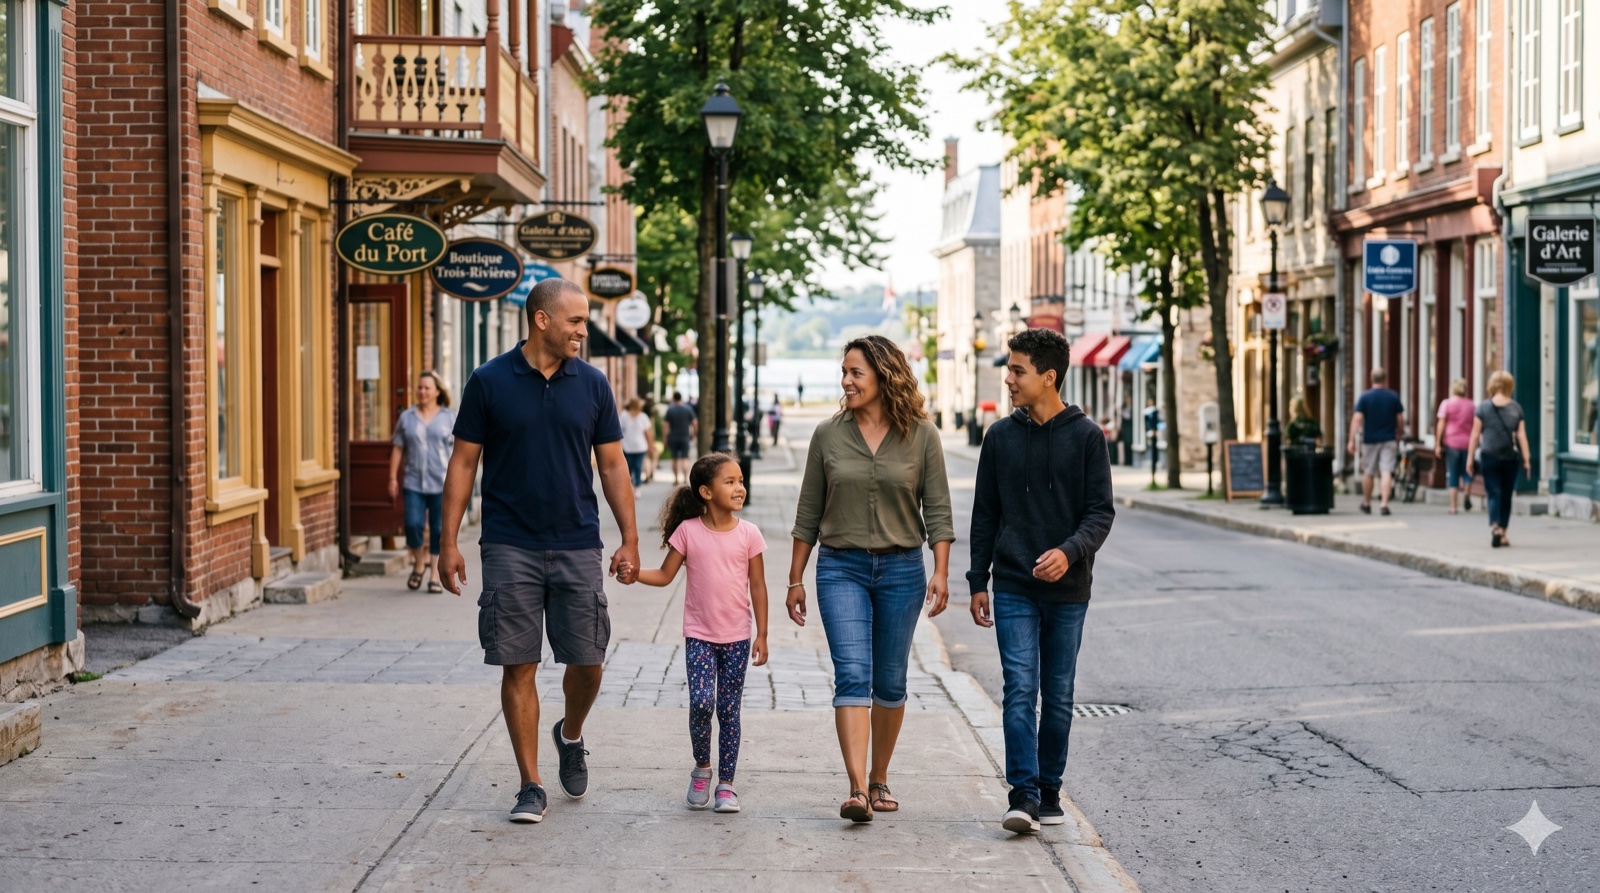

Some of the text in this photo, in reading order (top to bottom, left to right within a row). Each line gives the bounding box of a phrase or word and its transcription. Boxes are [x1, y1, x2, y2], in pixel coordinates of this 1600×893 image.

[367, 222, 415, 241] Café
[1532, 225, 1590, 242] Galerie
[354, 244, 427, 263] du Port
[1540, 243, 1582, 259] d'Art
[449, 252, 503, 267] Boutique
[436, 265, 517, 279] Trois-Rivières
